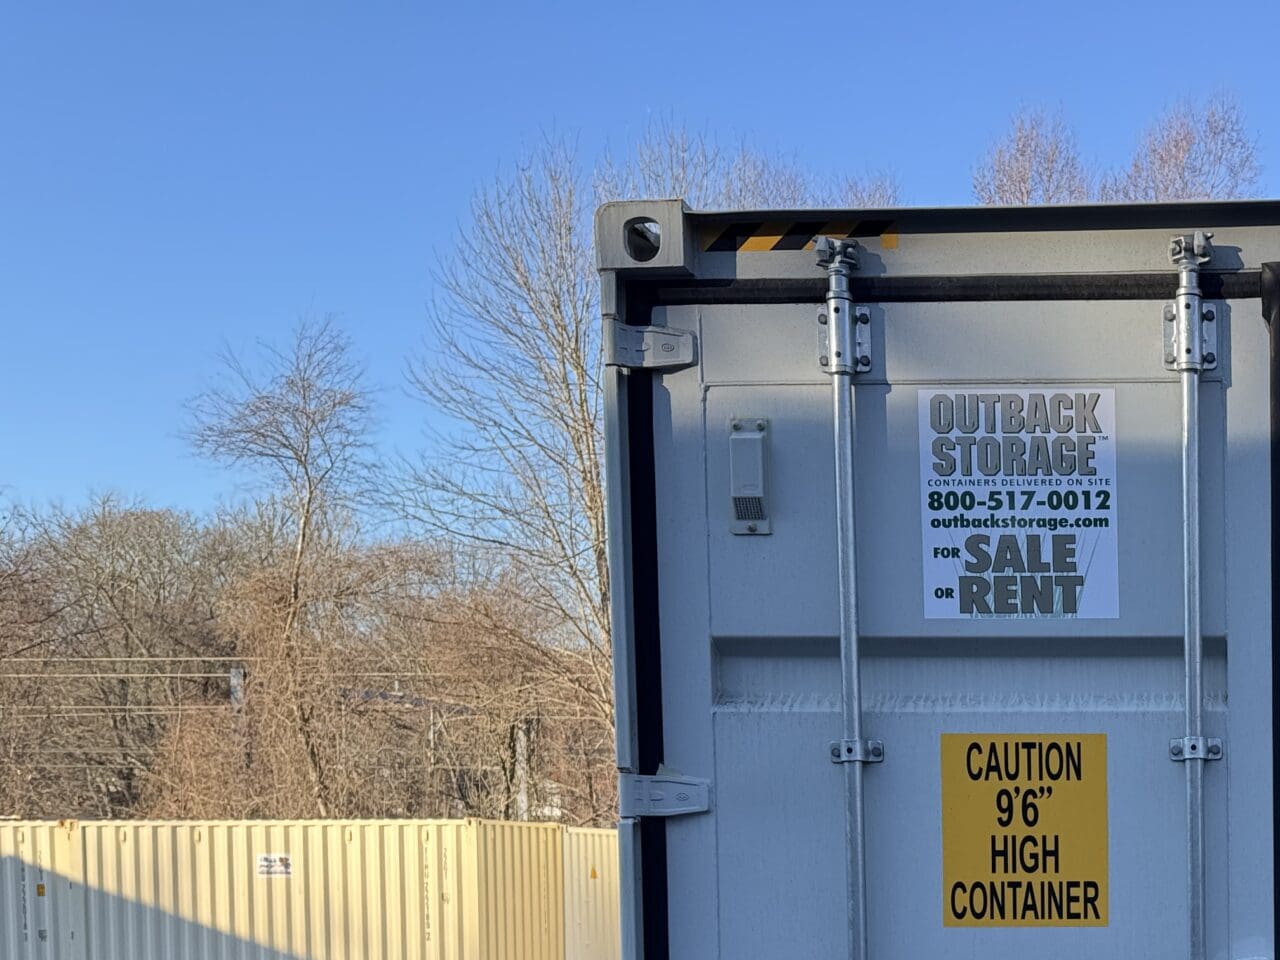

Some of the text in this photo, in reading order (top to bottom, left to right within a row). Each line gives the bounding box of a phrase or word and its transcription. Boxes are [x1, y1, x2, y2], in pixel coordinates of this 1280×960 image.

[930, 393, 1102, 434] OUTBACK
[931, 435, 1097, 476] STORAGE
[928, 479, 996, 487] CONTAINERS
[1088, 478, 1110, 486] SITE
[928, 490, 1110, 511] 800-517-0012
[931, 514, 1109, 530] outbackstorage.com
[934, 534, 1077, 573] FOR SALE
[935, 576, 1084, 614] OR RENT
[966, 742, 1081, 781] CAUTION
[991, 835, 1059, 873] HIGH
[951, 881, 1100, 919] CONTAINER
